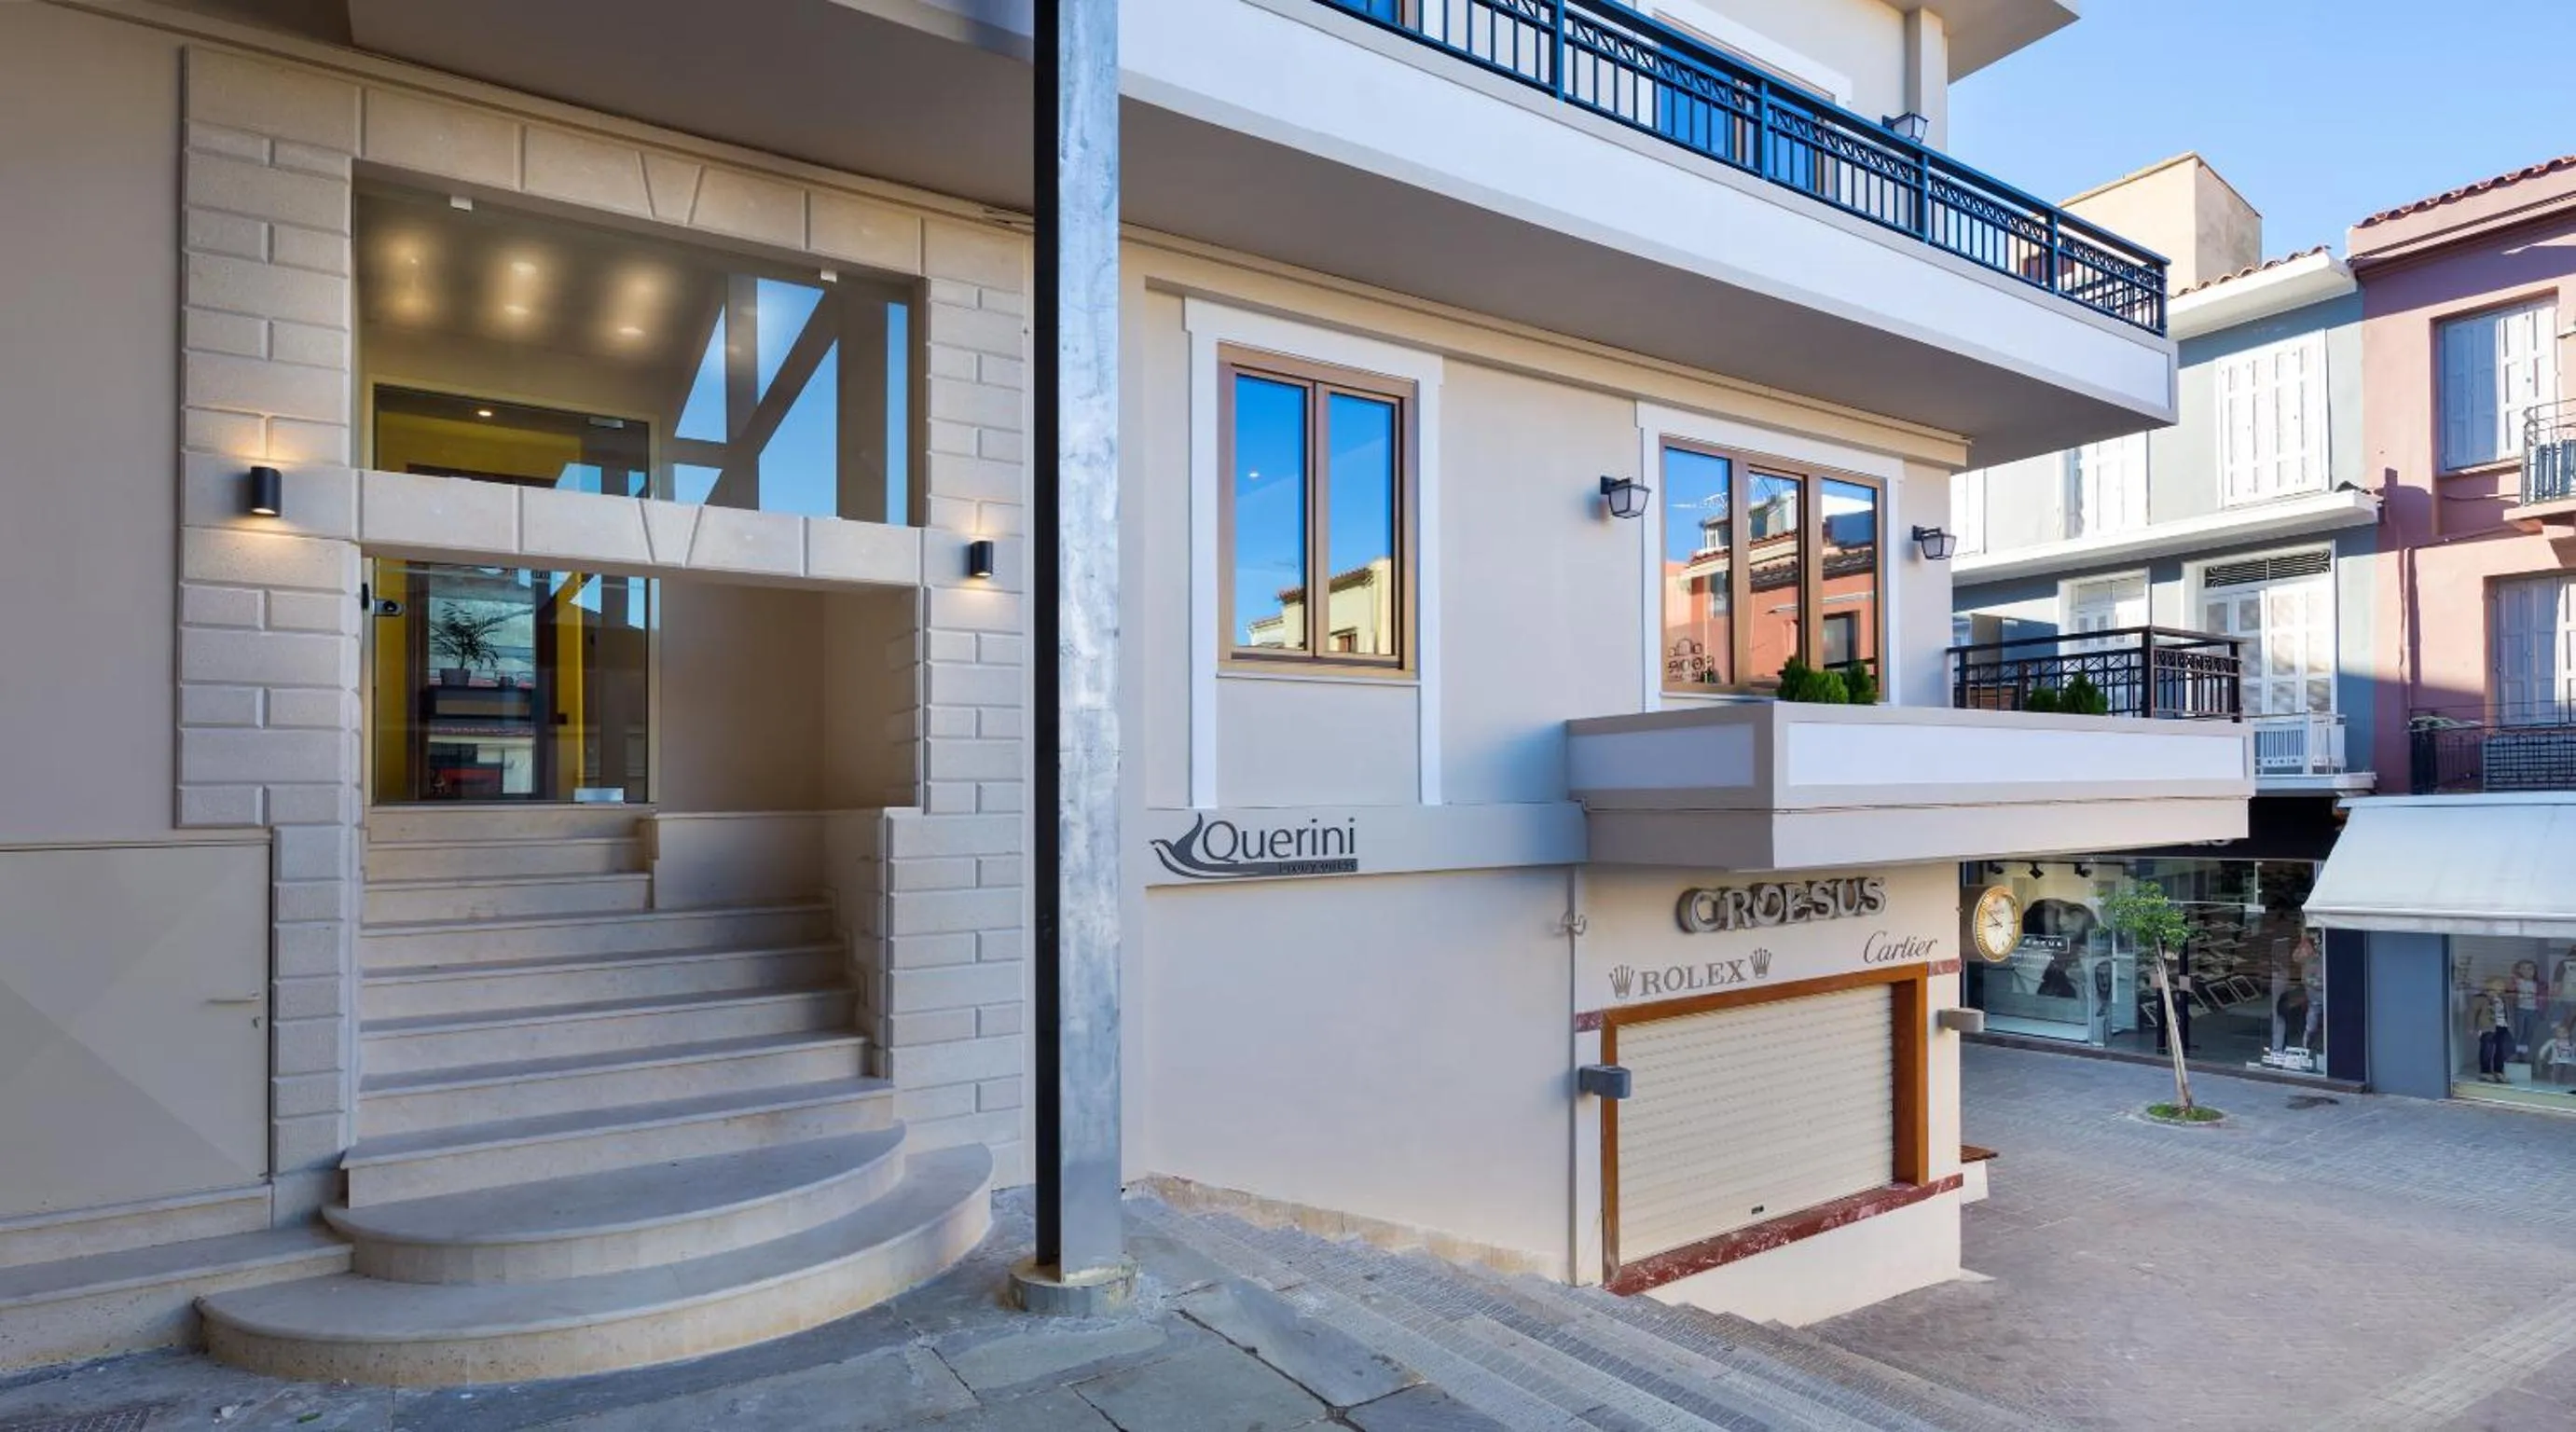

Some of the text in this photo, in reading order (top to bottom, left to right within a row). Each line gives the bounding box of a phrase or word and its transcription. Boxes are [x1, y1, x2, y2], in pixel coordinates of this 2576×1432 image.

[1203, 817, 1356, 863] Querini
[1675, 876, 1886, 934] CROESUS
[1863, 929, 1938, 964] Cartier
[1639, 958, 1747, 997] ROLEX
